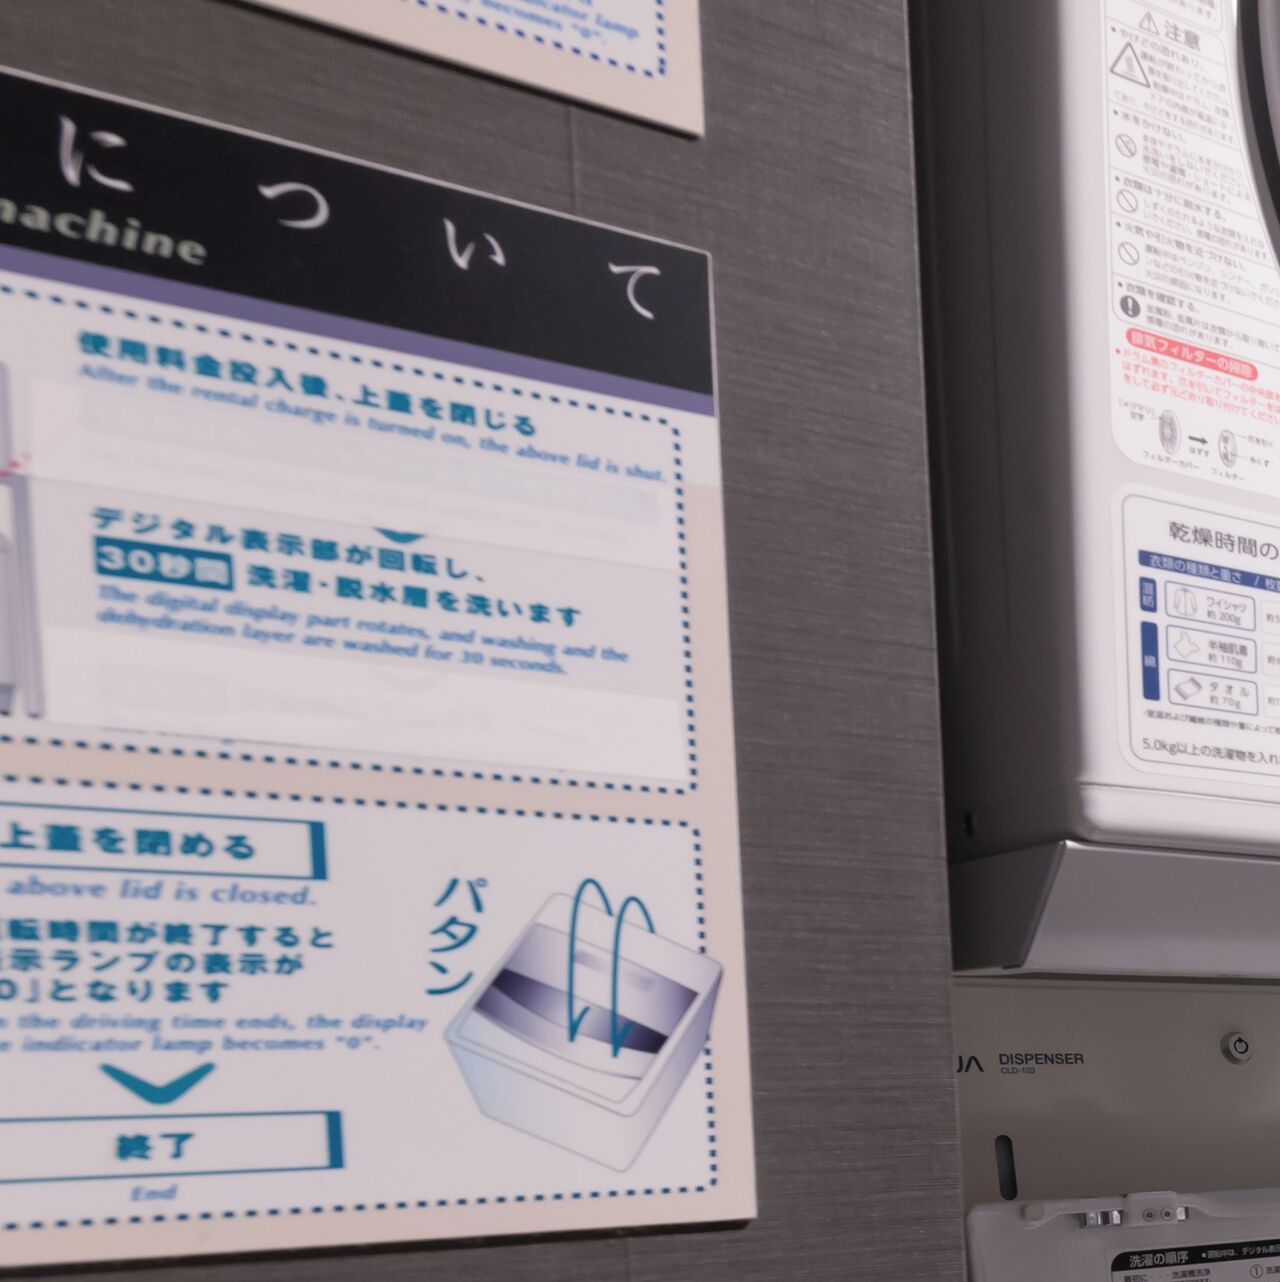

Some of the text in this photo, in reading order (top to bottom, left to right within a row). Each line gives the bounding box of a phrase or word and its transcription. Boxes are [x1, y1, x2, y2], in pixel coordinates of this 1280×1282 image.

[1163, 19, 1201, 51] 注意
[59, 115, 662, 320] について
[79, 364, 137, 387] After
[146, 375, 183, 395] the
[191, 386, 259, 408] rental
[265, 397, 337, 424] charge
[345, 406, 361, 426] is
[367, 417, 435, 440] turned
[479, 437, 509, 453] the
[515, 444, 570, 465] above
[576, 453, 600, 470] lid
[606, 459, 619, 474] is
[625, 464, 667, 483] shut.
[146, 590, 219, 612] digital
[224, 601, 298, 624] display
[306, 613, 350, 629] part
[356, 619, 431, 640] rotates,
[439, 629, 476, 644] and
[481, 636, 556, 659] washing
[562, 645, 596, 659] and
[601, 646, 629, 662] the
[242, 624, 294, 644] layer
[302, 635, 335, 648] are
[424, 643, 453, 661] for
[460, 651, 484, 664] 30
[489, 654, 567, 675] seconds.
[1, 822, 255, 860] 上蓋を閉める
[6, 875, 318, 907] above lid is closed.
[0, 918, 334, 948] 転時間が終了すると
[427, 877, 489, 998] パタン
[0, 949, 304, 975] 示ランプの表示が
[17, 1014, 428, 1034] the driving time ends, the display
[22, 1034, 324, 1055] indicator lamp becomes
[998, 1053, 1084, 1065] DISPENSER
[116, 1131, 195, 1160] 終了
[130, 1184, 179, 1201] End
[1129, 1250, 1189, 1269] 洗濯の順序
